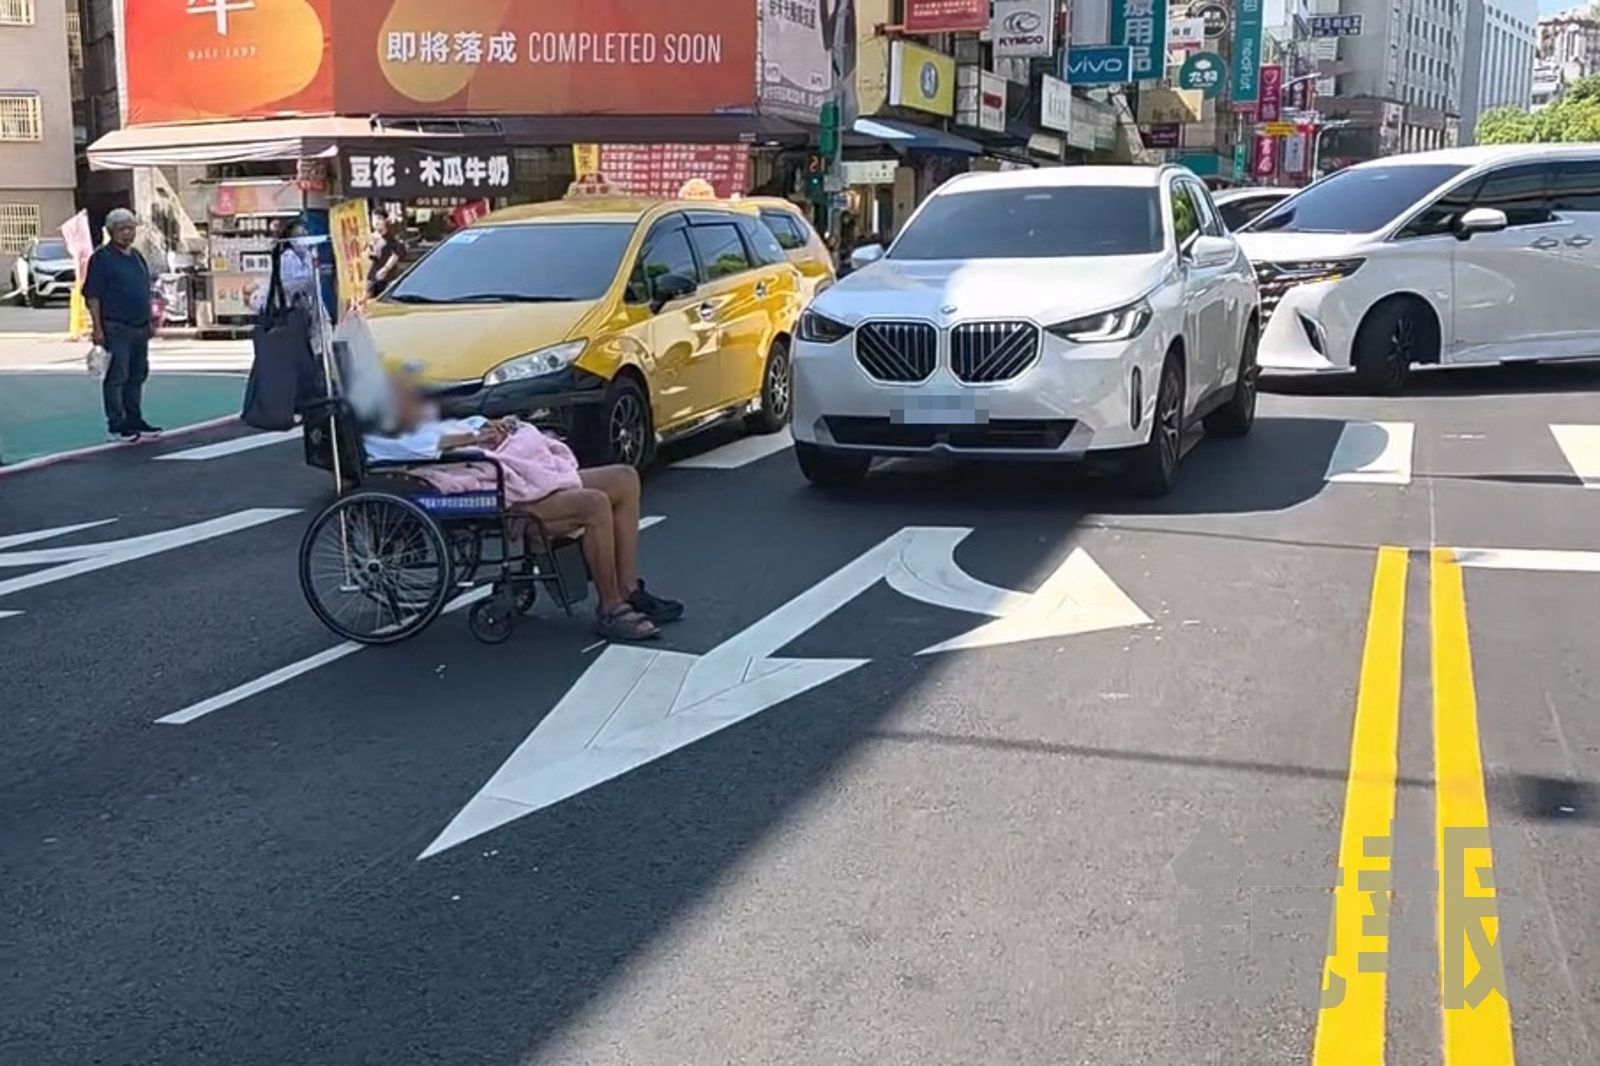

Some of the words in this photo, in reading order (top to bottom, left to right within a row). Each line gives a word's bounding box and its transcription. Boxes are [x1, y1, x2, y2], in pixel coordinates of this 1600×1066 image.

[387, 31, 517, 63] 即將落成
[528, 32, 656, 64] COMPLETED
[663, 33, 722, 64] SOON
[998, 35, 1044, 47] KYMCO
[1068, 55, 1123, 73] vivo
